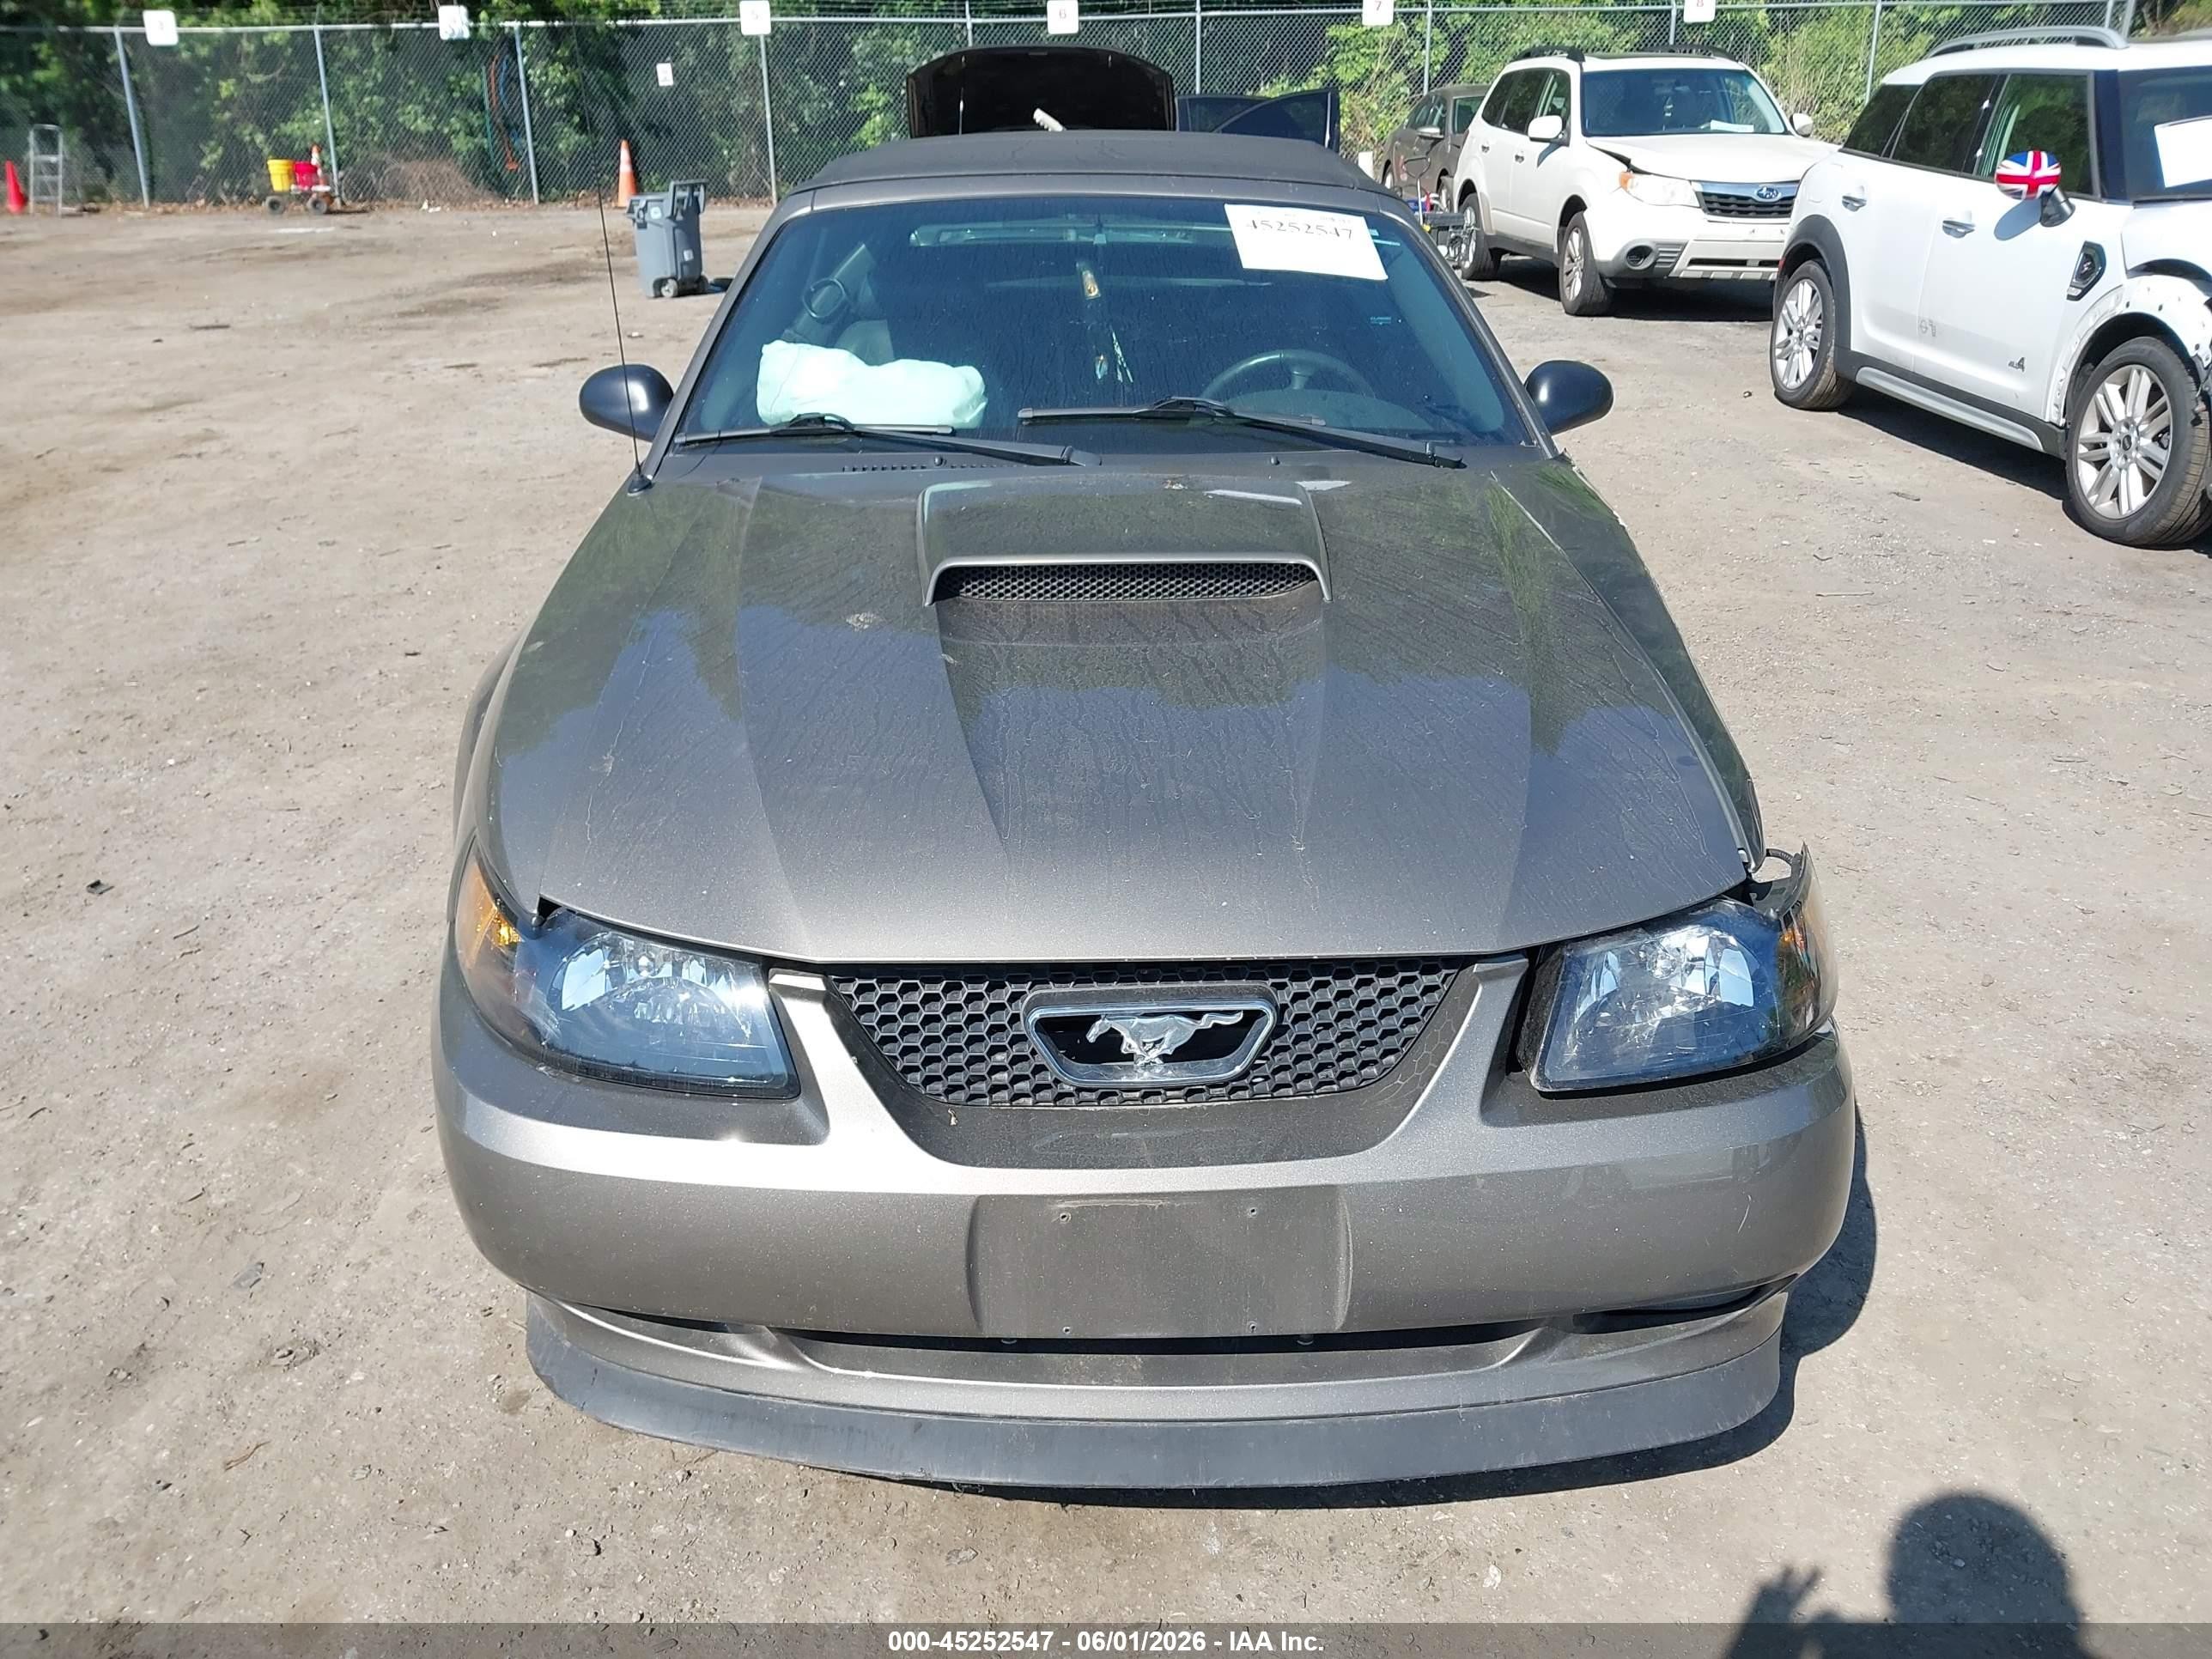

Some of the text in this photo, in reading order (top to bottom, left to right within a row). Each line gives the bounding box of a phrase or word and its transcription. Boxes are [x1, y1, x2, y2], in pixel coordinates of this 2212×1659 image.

[1374, 0, 1382, 11] 7
[1059, 8, 1066, 19] 6
[1246, 219, 1352, 239] 45252547
